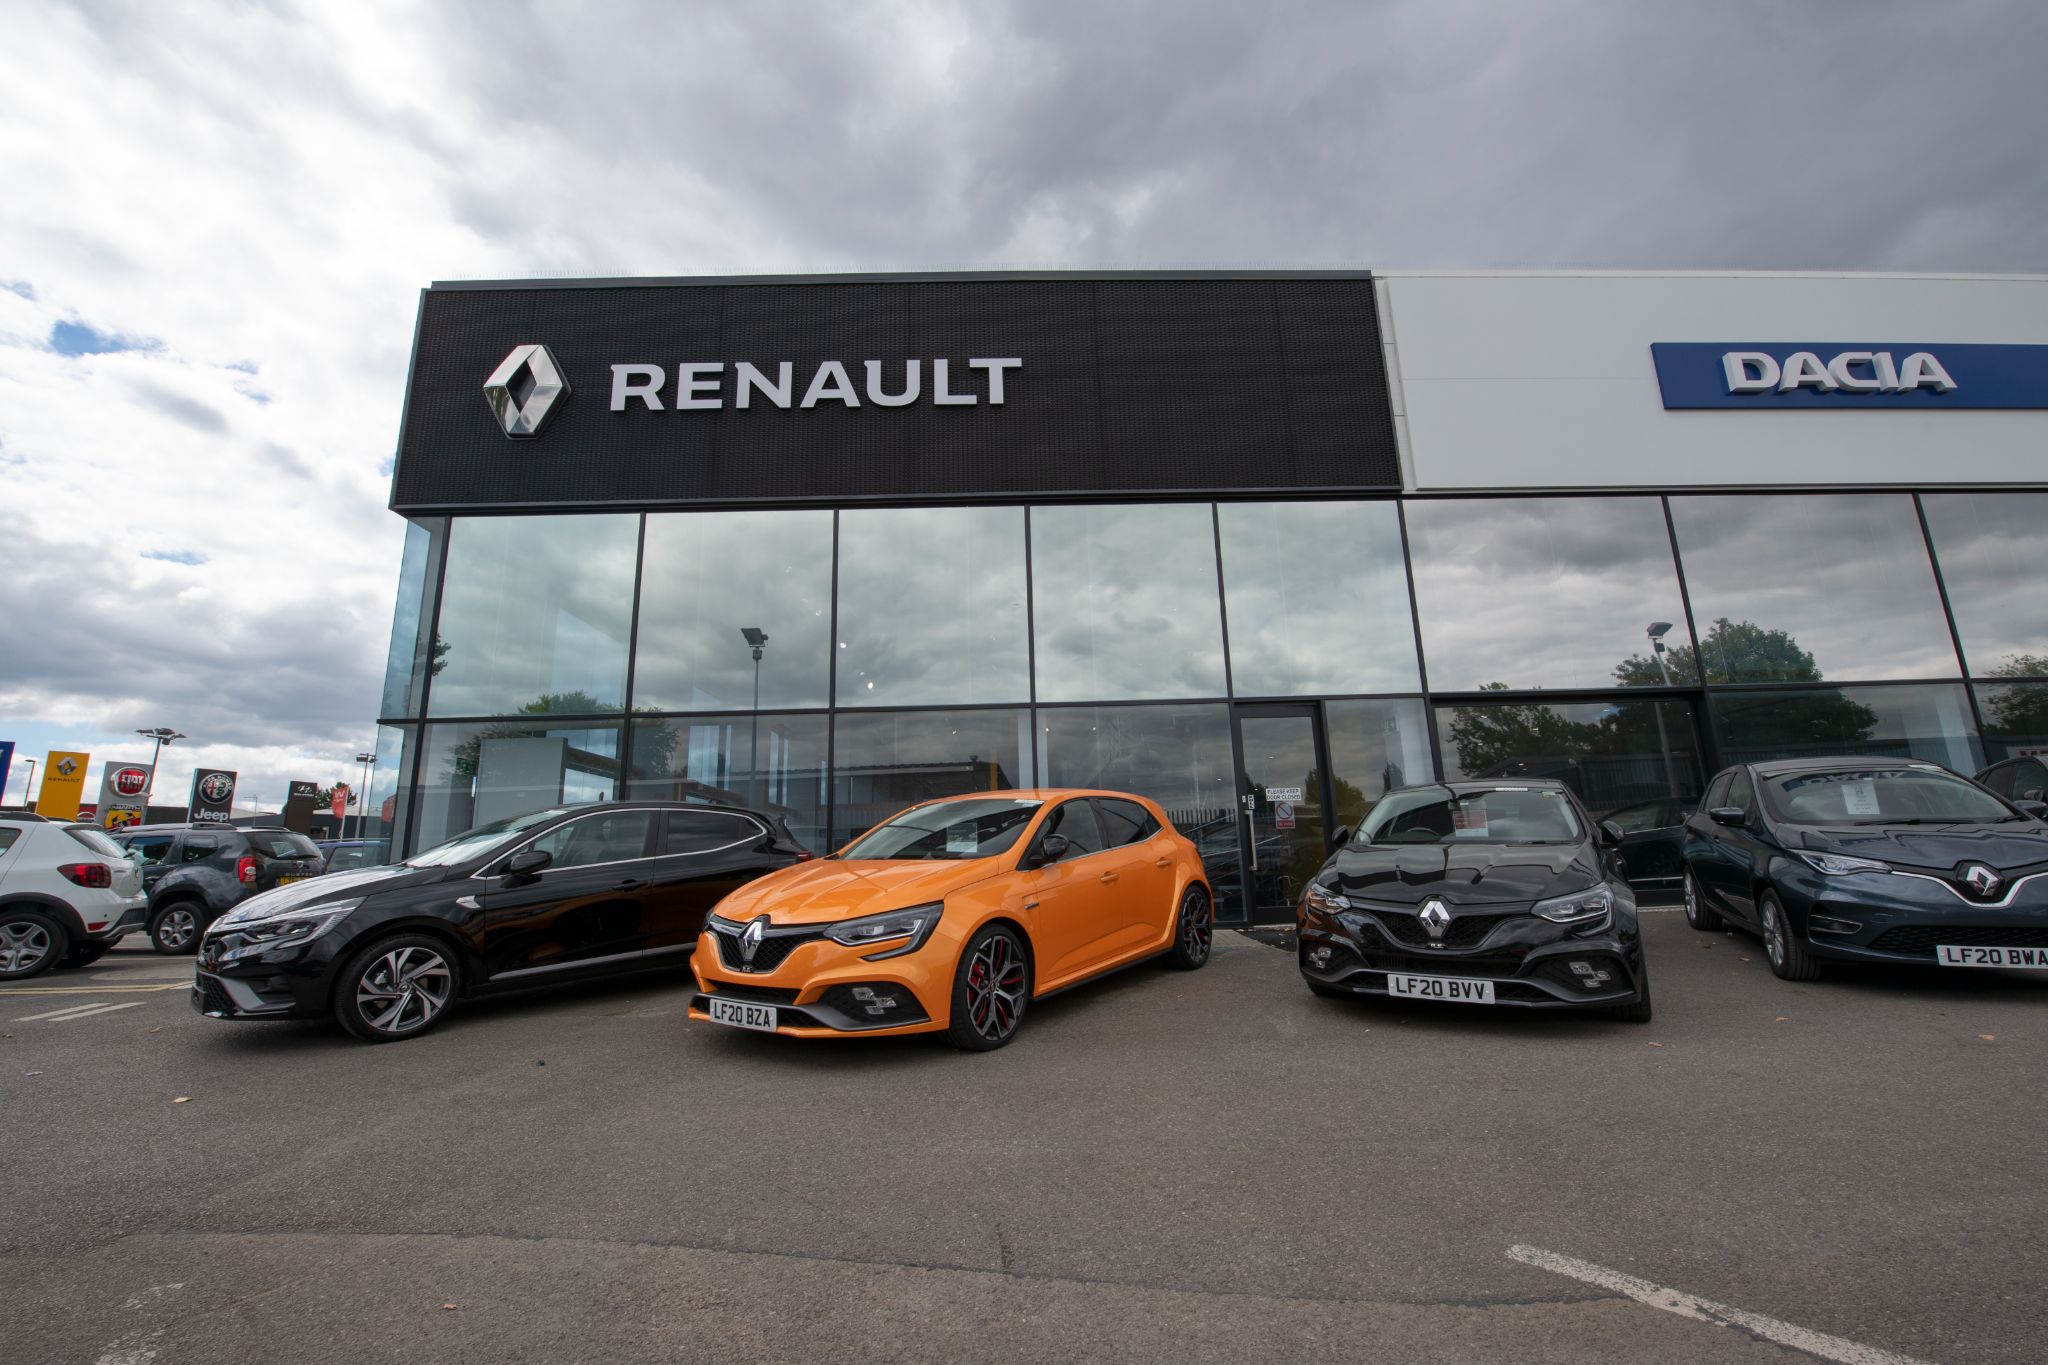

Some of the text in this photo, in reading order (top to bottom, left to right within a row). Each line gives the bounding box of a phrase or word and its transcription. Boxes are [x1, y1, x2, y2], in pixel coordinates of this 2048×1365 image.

[1722, 352, 1957, 392] DACIA
[610, 357, 1022, 412] RENAULT
[121, 774, 145, 785] FIAT
[194, 808, 229, 822] Jeep
[1946, 947, 2048, 966] LF20 BWA
[1395, 977, 1485, 1000] LF20 BVV
[714, 1002, 771, 1028] LF20 BZA
